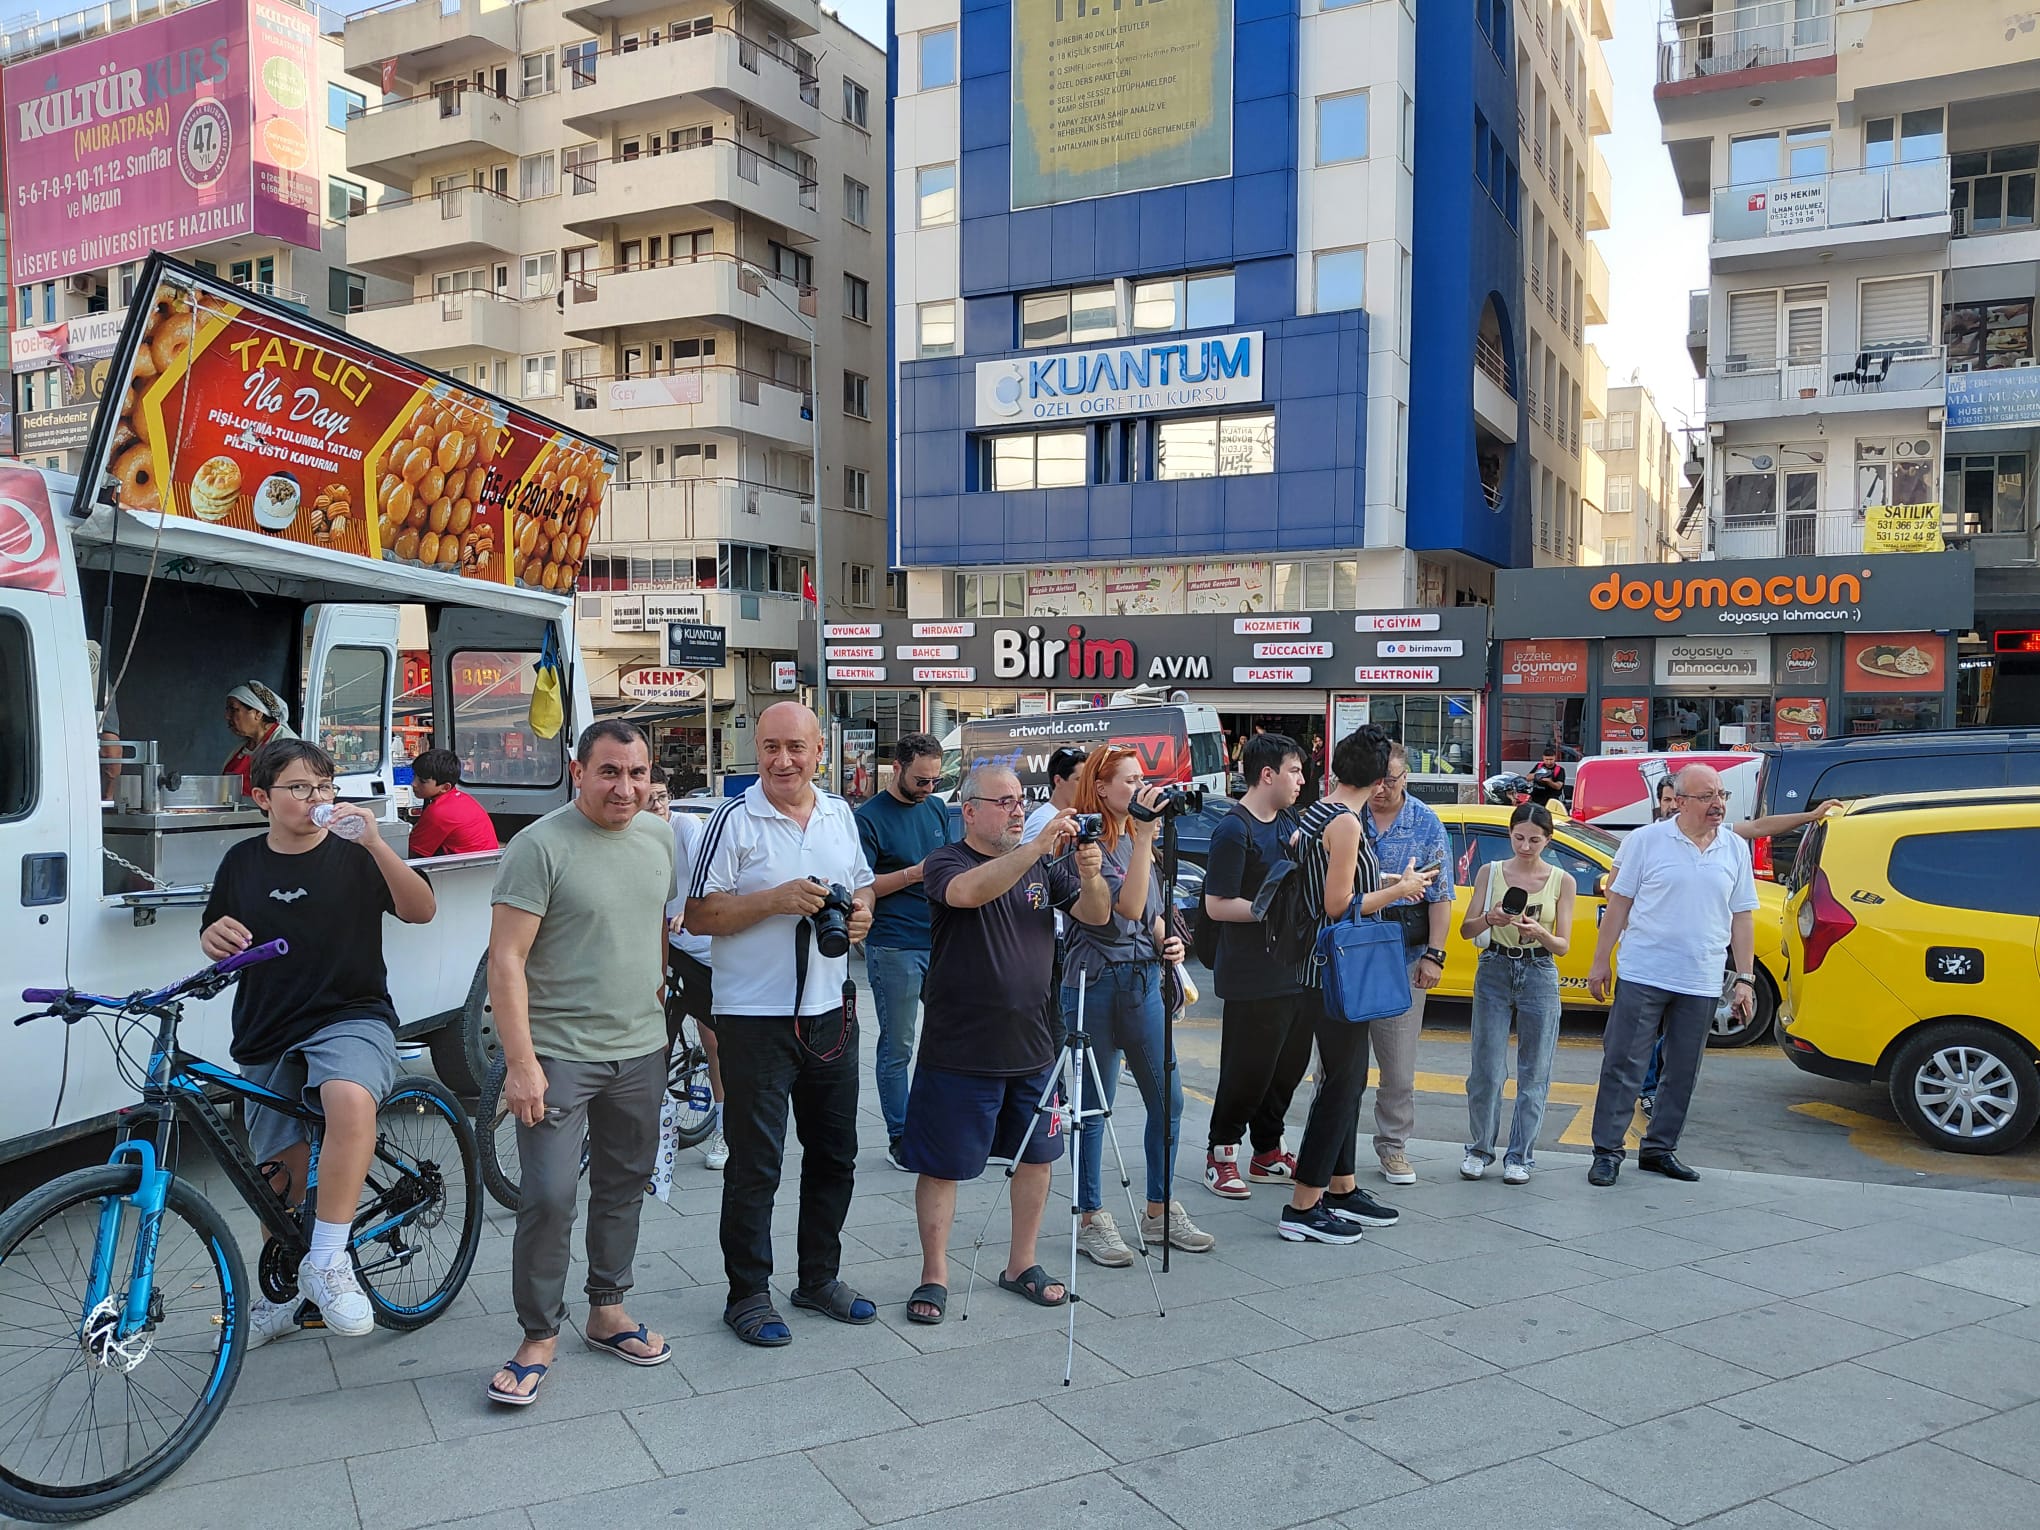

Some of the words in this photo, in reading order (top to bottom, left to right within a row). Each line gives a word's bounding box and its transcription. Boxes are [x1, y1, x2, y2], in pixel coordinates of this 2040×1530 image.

[18, 61, 146, 142] KÜLTÜR
[145, 38, 229, 103] KURS
[73, 102, 170, 161] (MURATPAŞA)
[193, 122, 217, 154] 47.
[126, 145, 173, 178] Sınıflar
[1774, 192, 1788, 202] DİŞ
[1790, 188, 1821, 199] HEKİMİ
[66, 200, 80, 219] ve
[81, 188, 121, 216] Mezun
[16, 250, 58, 278] LİSEYE
[60, 248, 77, 265] ve
[79, 219, 175, 262] ÜNİVERSİTEYE
[179, 202, 246, 237] HAZIRLIK
[230, 337, 373, 408] TATLICI
[1029, 337, 1250, 398] KUANTUM
[1167, 386, 1227, 405] KURSU
[243, 367, 283, 413] İbo
[289, 387, 352, 441] Dayı
[259, 442, 288, 460] ÜSTÜ
[290, 451, 339, 473] KAVURMA
[327, 440, 363, 461] TATLISI
[1884, 505, 1934, 519] SATILIK
[1877, 520, 1892, 529] 531
[1876, 532, 1891, 541] 531
[1894, 532, 1910, 541] 512
[1589, 572, 1861, 622] doymacun
[648, 606, 664, 617] DİŞ
[666, 605, 698, 616] HEKİMİ
[1718, 609, 1779, 625] doyasıya
[1783, 608, 1850, 622] lahmacun
[832, 625, 871, 637] OYUNCAK
[922, 624, 964, 636] HIRDAVAT
[1244, 620, 1300, 631] KOZMETİK
[1373, 616, 1385, 632] İÇ
[1387, 616, 1421, 629] GİYİM
[684, 628, 722, 641] KUANTUM
[833, 646, 874, 659] KIRTASİYE
[912, 646, 941, 660] BAHÇE
[993, 624, 1135, 679] Birim
[1148, 655, 1210, 680] AVM
[1261, 644, 1324, 657] ZÜCCACİYE
[1409, 644, 1452, 654] birimavm
[1514, 651, 1552, 661] lezzete
[836, 667, 875, 679] ELEKTRİK
[918, 668, 932, 679] EV
[932, 666, 969, 679] TEKSTİLİ
[1248, 667, 1294, 680] PLASTİK
[1359, 667, 1433, 680] ELEKTRONİK
[1511, 660, 1577, 676] doymaya
[1672, 662, 1739, 673] lahmacun
[639, 671, 685, 685] KENT
[1008, 719, 1111, 738] artworld.com.tr
[1808, 728, 1824, 736] 130
